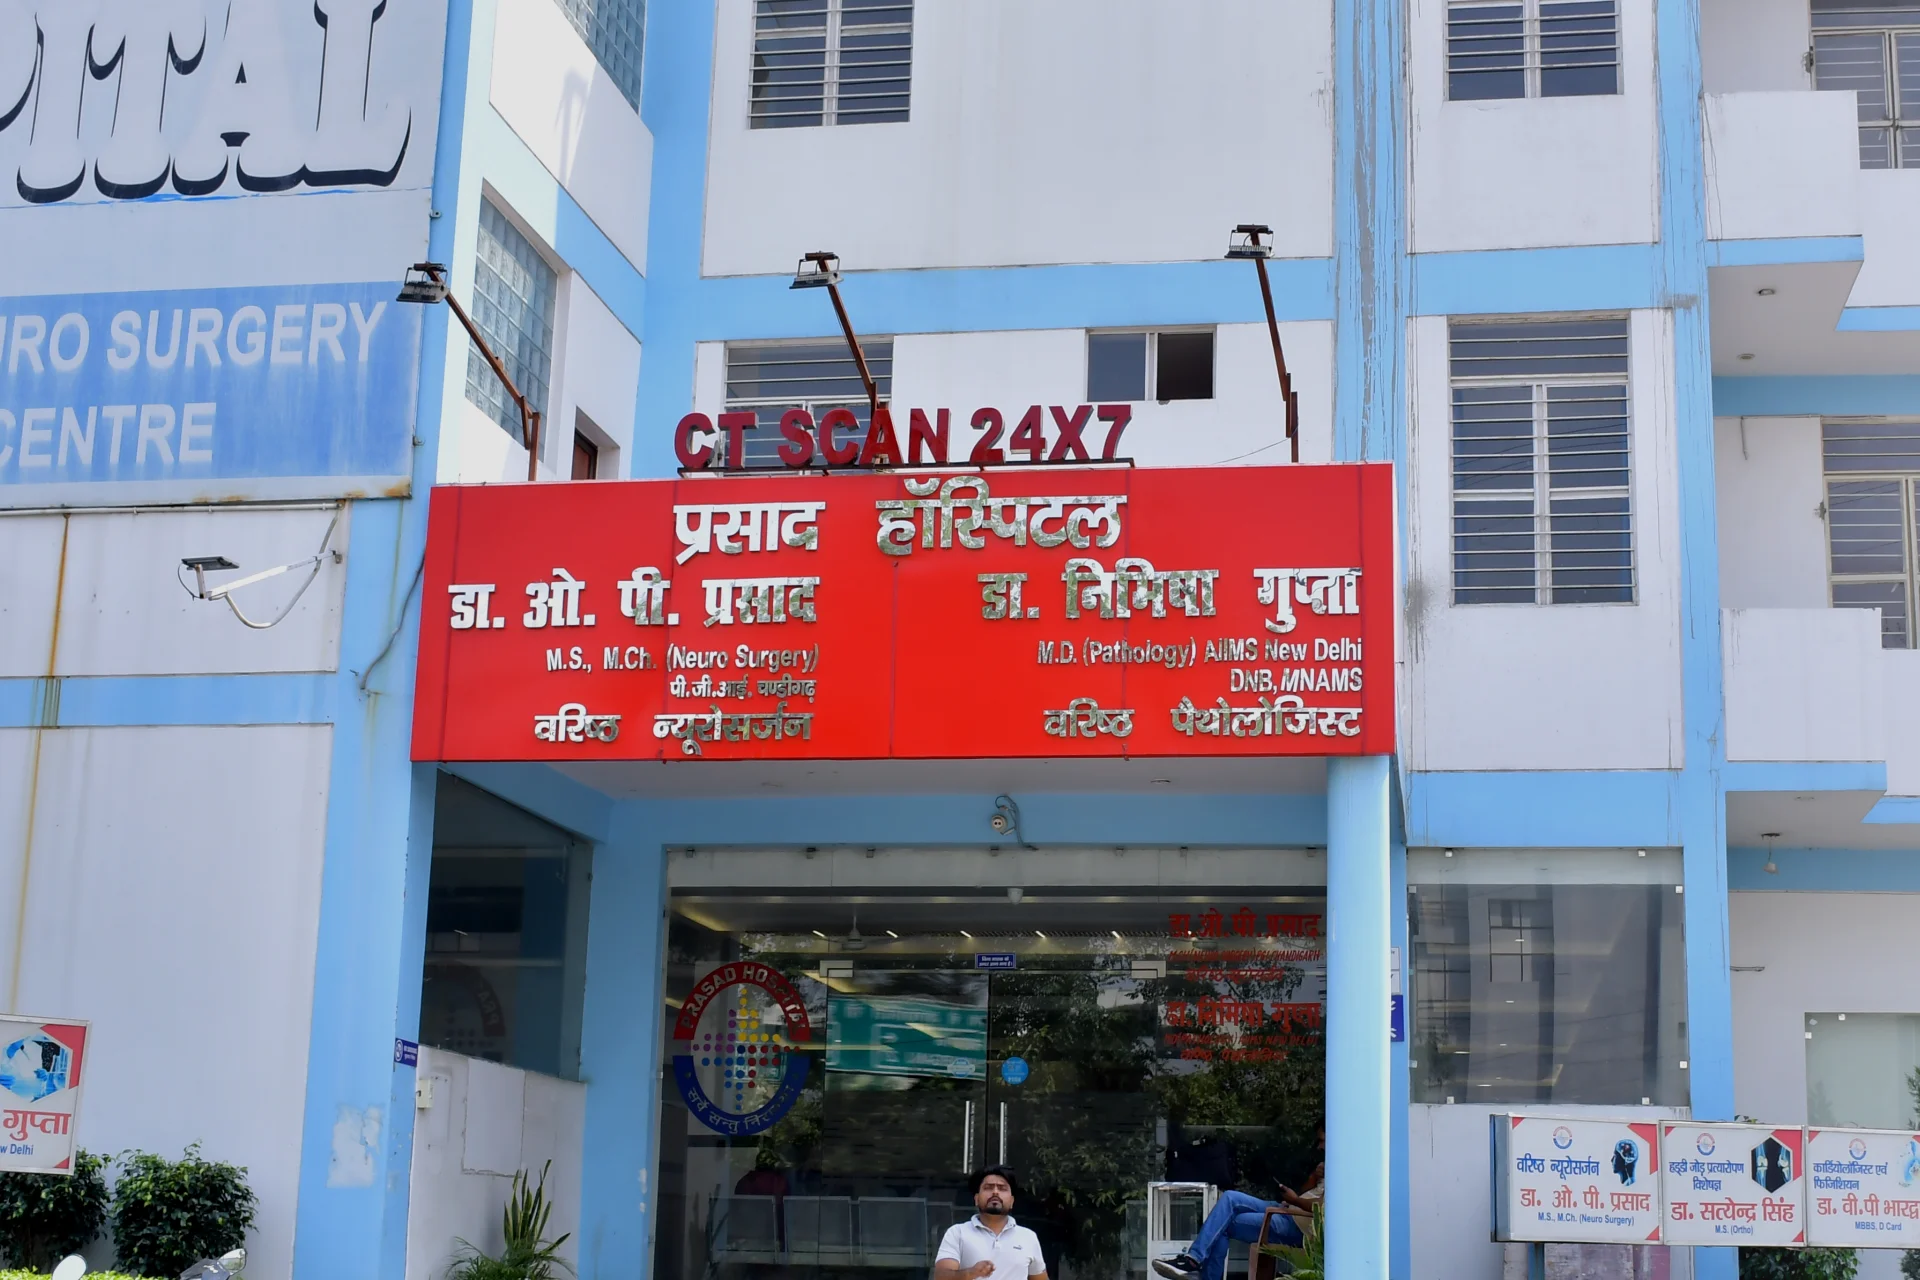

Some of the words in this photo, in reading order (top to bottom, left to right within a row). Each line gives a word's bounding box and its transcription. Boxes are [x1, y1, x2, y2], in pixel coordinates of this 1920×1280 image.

[0, 312, 91, 373] RO
[106, 301, 388, 370] SURGERY
[674, 412, 759, 469] CT
[777, 407, 951, 469] SCAN
[969, 404, 1132, 465] 24X7
[673, 501, 826, 565] प्रसाद
[875, 476, 1128, 555] हॉस्पिटल
[448, 583, 505, 629] डा.
[523, 568, 595, 628] ओ.
[617, 566, 680, 626] पी.
[702, 576, 820, 628] प्रसाद
[977, 572, 1041, 619] डा.
[1061, 557, 1219, 619] निमिषा
[1253, 566, 1363, 633] गुप्ता
[546, 646, 592, 673] M.S.,
[603, 645, 657, 671] M.Ch.
[666, 643, 729, 672] (Neuro
[734, 643, 819, 673] Surgery)
[1037, 639, 1077, 665] M.D.
[1082, 636, 1197, 669] (Pathology)
[1264, 638, 1308, 662] New
[1314, 637, 1363, 662] Delhi
[757, 672, 817, 703] चण्डीगढ़
[534, 703, 622, 742] वरिष्ठ
[652, 700, 815, 755] न्यूरोसर्जन
[1043, 697, 1136, 738] वरिष्ठ
[1170, 694, 1363, 738] पैथोलोजिस्ट
[679, 966, 738, 1029] PRASAD
[2, 1109, 72, 1142] गुप्ता
[10, 1143, 34, 1156] Delhi
[1516, 1153, 1545, 1174] वरिष्ठ
[1549, 1156, 1600, 1180] न्यूरोसर्जन
[1706, 1160, 1745, 1175] प्रत्यारोपण
[1693, 1176, 1722, 1191] विशेषज्ञ
[1813, 1176, 1860, 1190] फिजिशियन
[1520, 1188, 1542, 1208] डा.
[1552, 1185, 1578, 1209] ओ.
[1583, 1185, 1605, 1210] पी.
[1610, 1192, 1651, 1213] प्रसाद
[1671, 1202, 1694, 1221] डा.
[1699, 1197, 1758, 1224] सत्येन्द्र
[1762, 1196, 1795, 1223] सिंह
[1816, 1197, 1837, 1216] डा.
[1557, 1212, 1578, 1223] M.Ch.
[1579, 1213, 1603, 1225] (Neuro
[1604, 1215, 1635, 1227] Surgery)
[1715, 1224, 1730, 1235] M.S.
[1730, 1225, 1754, 1236] (Ortho)
[1879, 1222, 1884, 1231] D
[1886, 1222, 1902, 1231] Card
